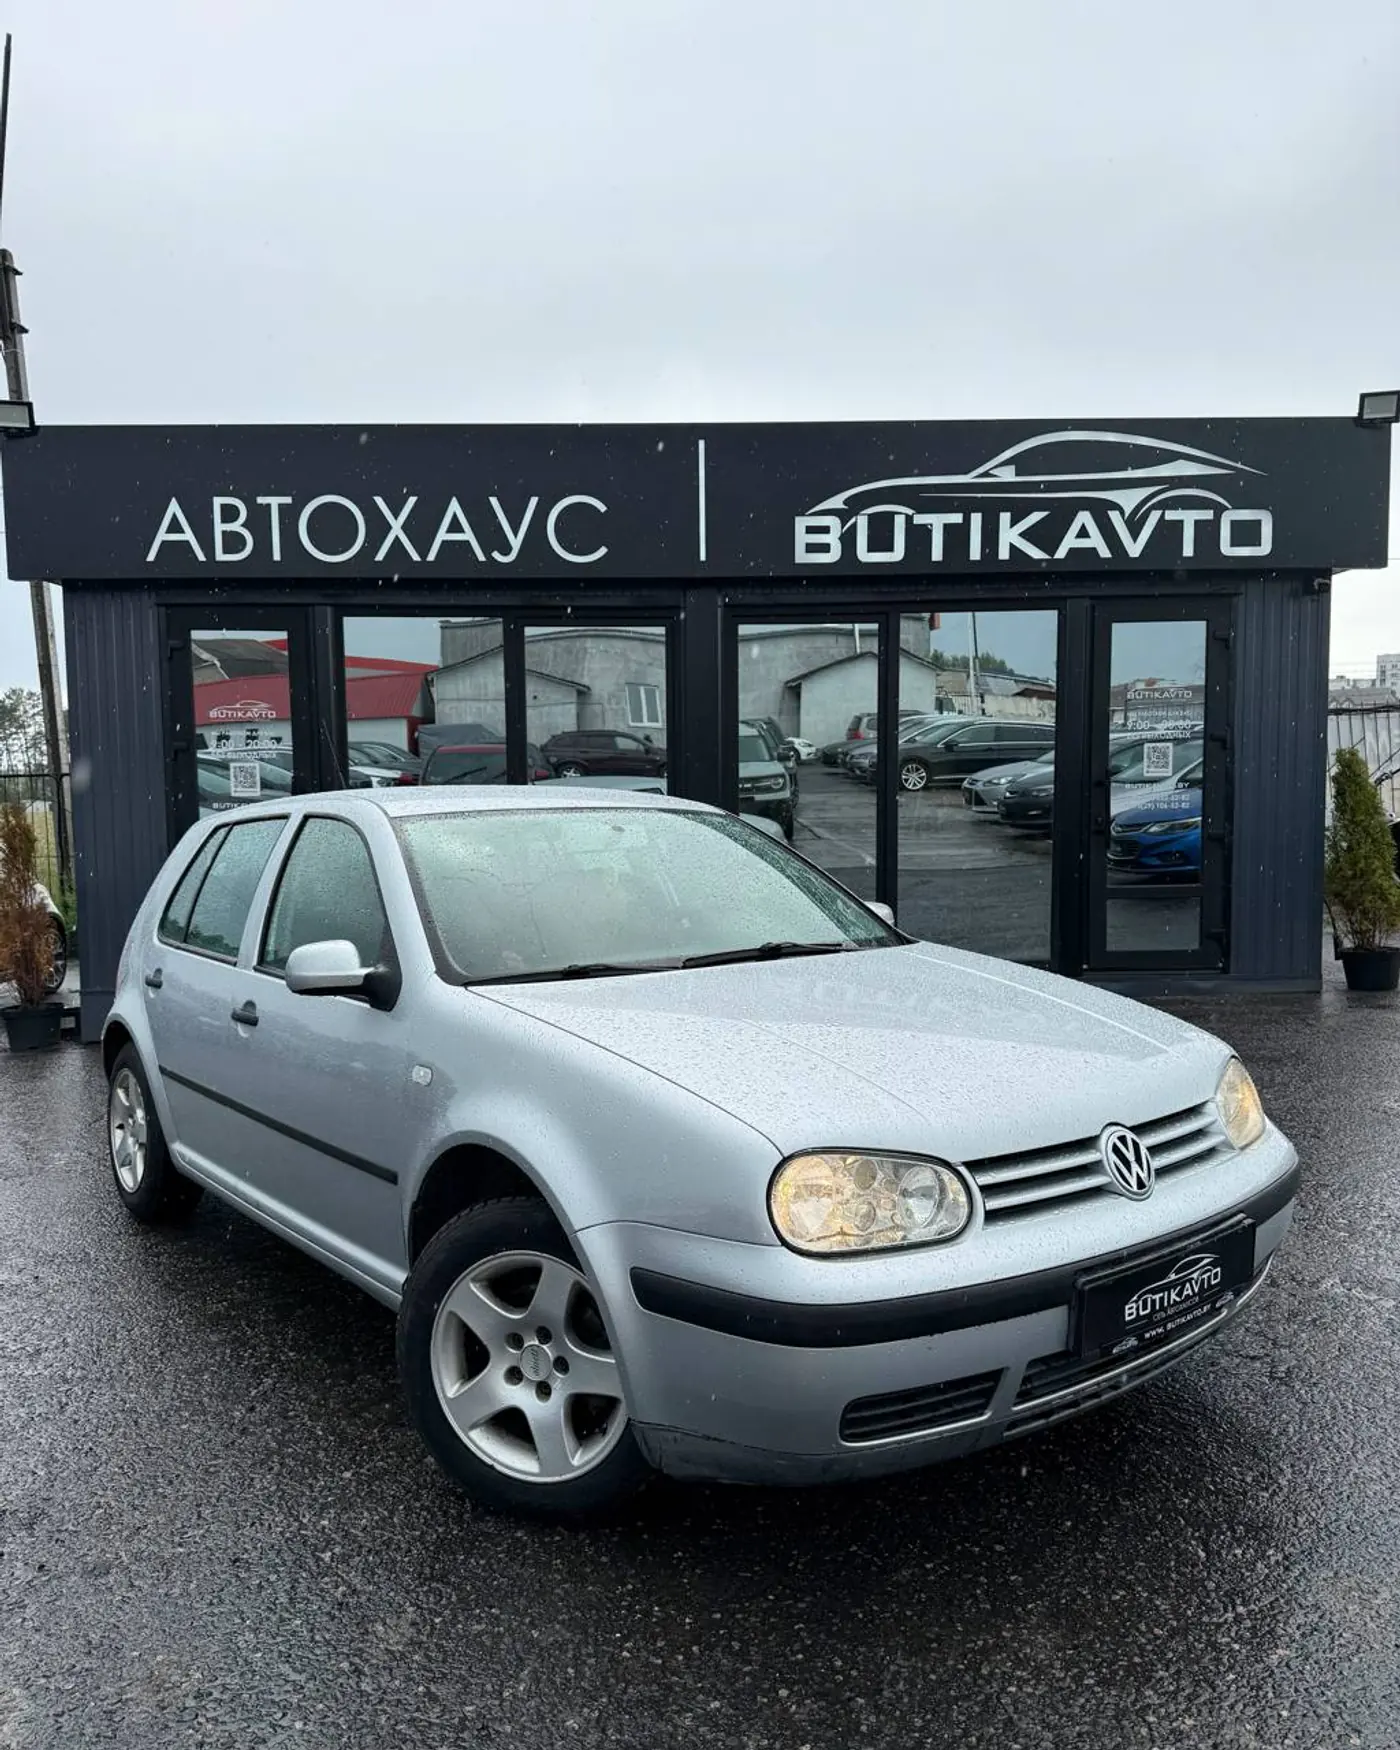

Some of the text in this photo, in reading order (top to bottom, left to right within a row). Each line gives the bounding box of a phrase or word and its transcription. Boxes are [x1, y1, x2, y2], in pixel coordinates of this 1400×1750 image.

[145, 494, 609, 563] АВТОХАУС
[794, 508, 1273, 564] BUTIKAVTO
[1126, 690, 1192, 699] BUTIKAVTO
[209, 709, 276, 718] BUTIKAVTO
[1126, 720, 1150, 730] 9:00
[1125, 1267, 1221, 1322] BUTIKAVTO
